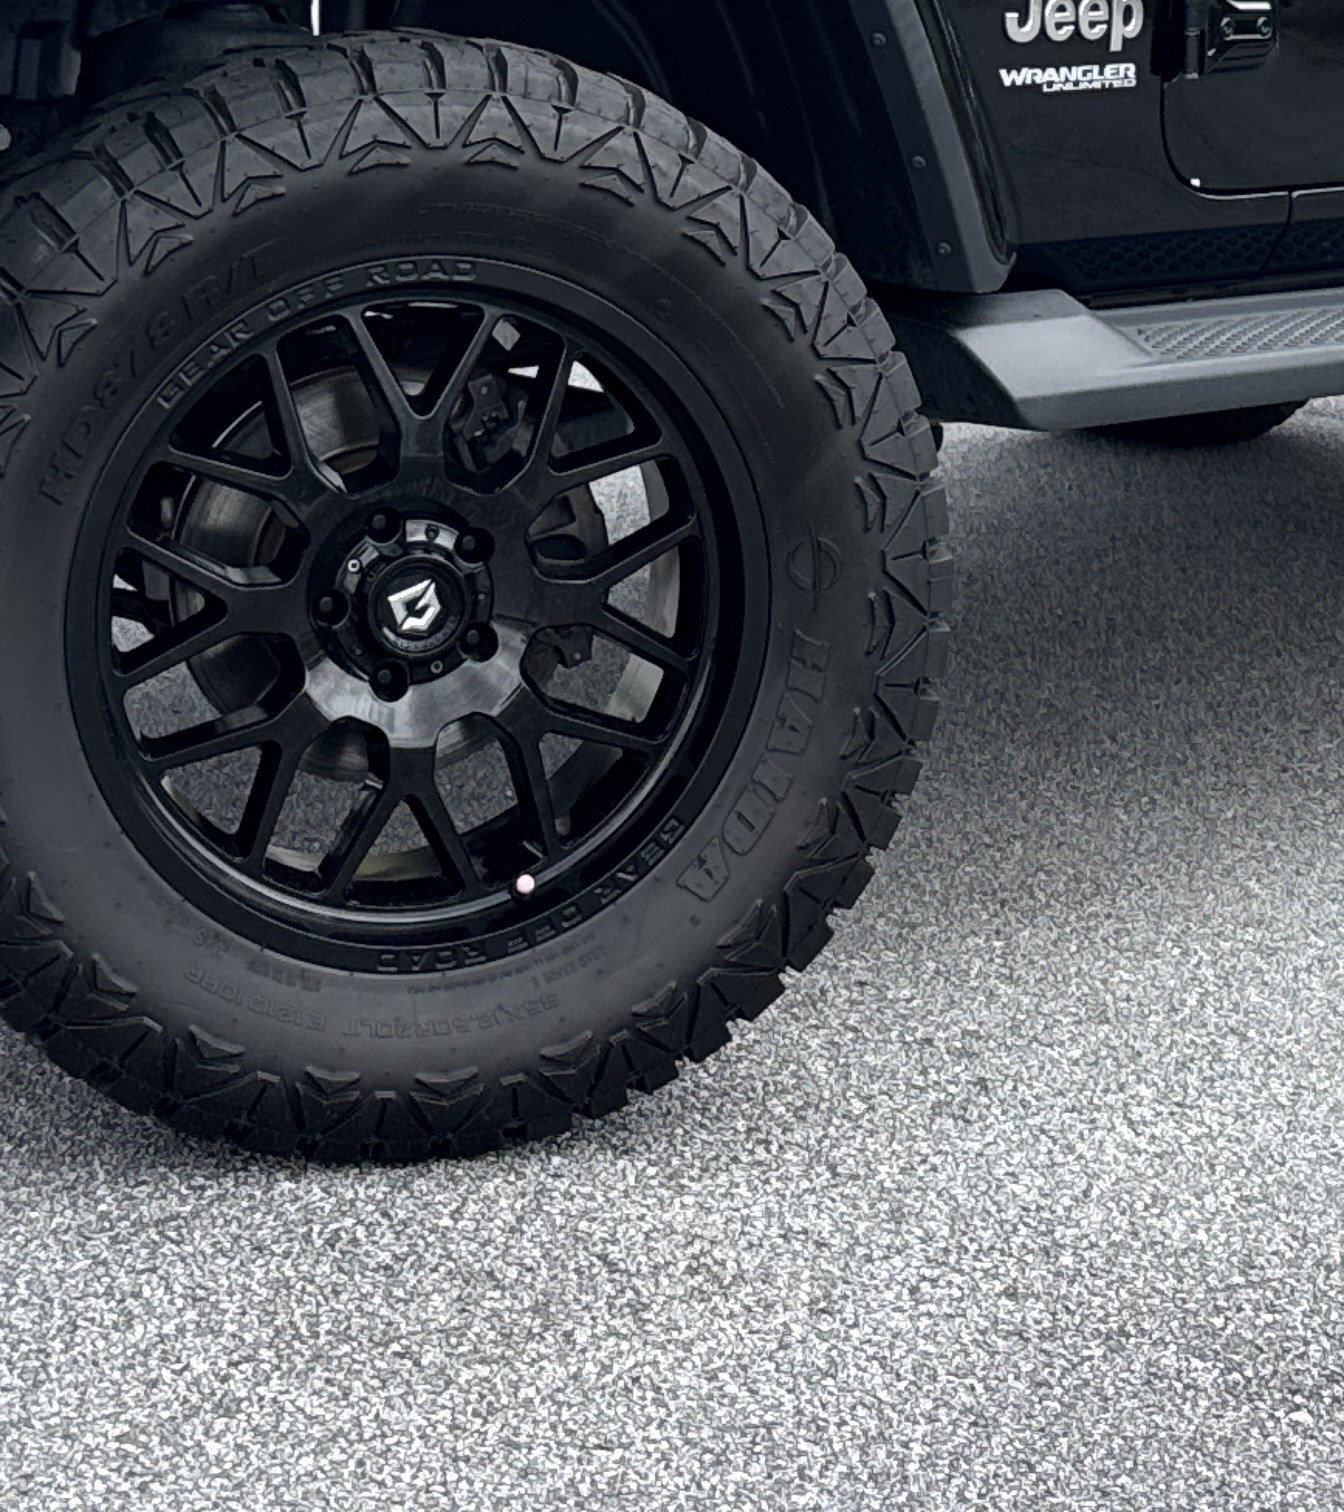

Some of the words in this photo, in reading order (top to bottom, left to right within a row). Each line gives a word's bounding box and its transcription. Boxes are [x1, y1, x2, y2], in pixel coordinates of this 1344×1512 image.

[998, 62, 1137, 87] WRANGLER
[1042, 78, 1138, 93] UNLIMITED
[157, 318, 254, 410] GEAR
[266, 276, 346, 323] OFF
[365, 258, 479, 288] ROAD
[376, 943, 488, 973] ROAD
